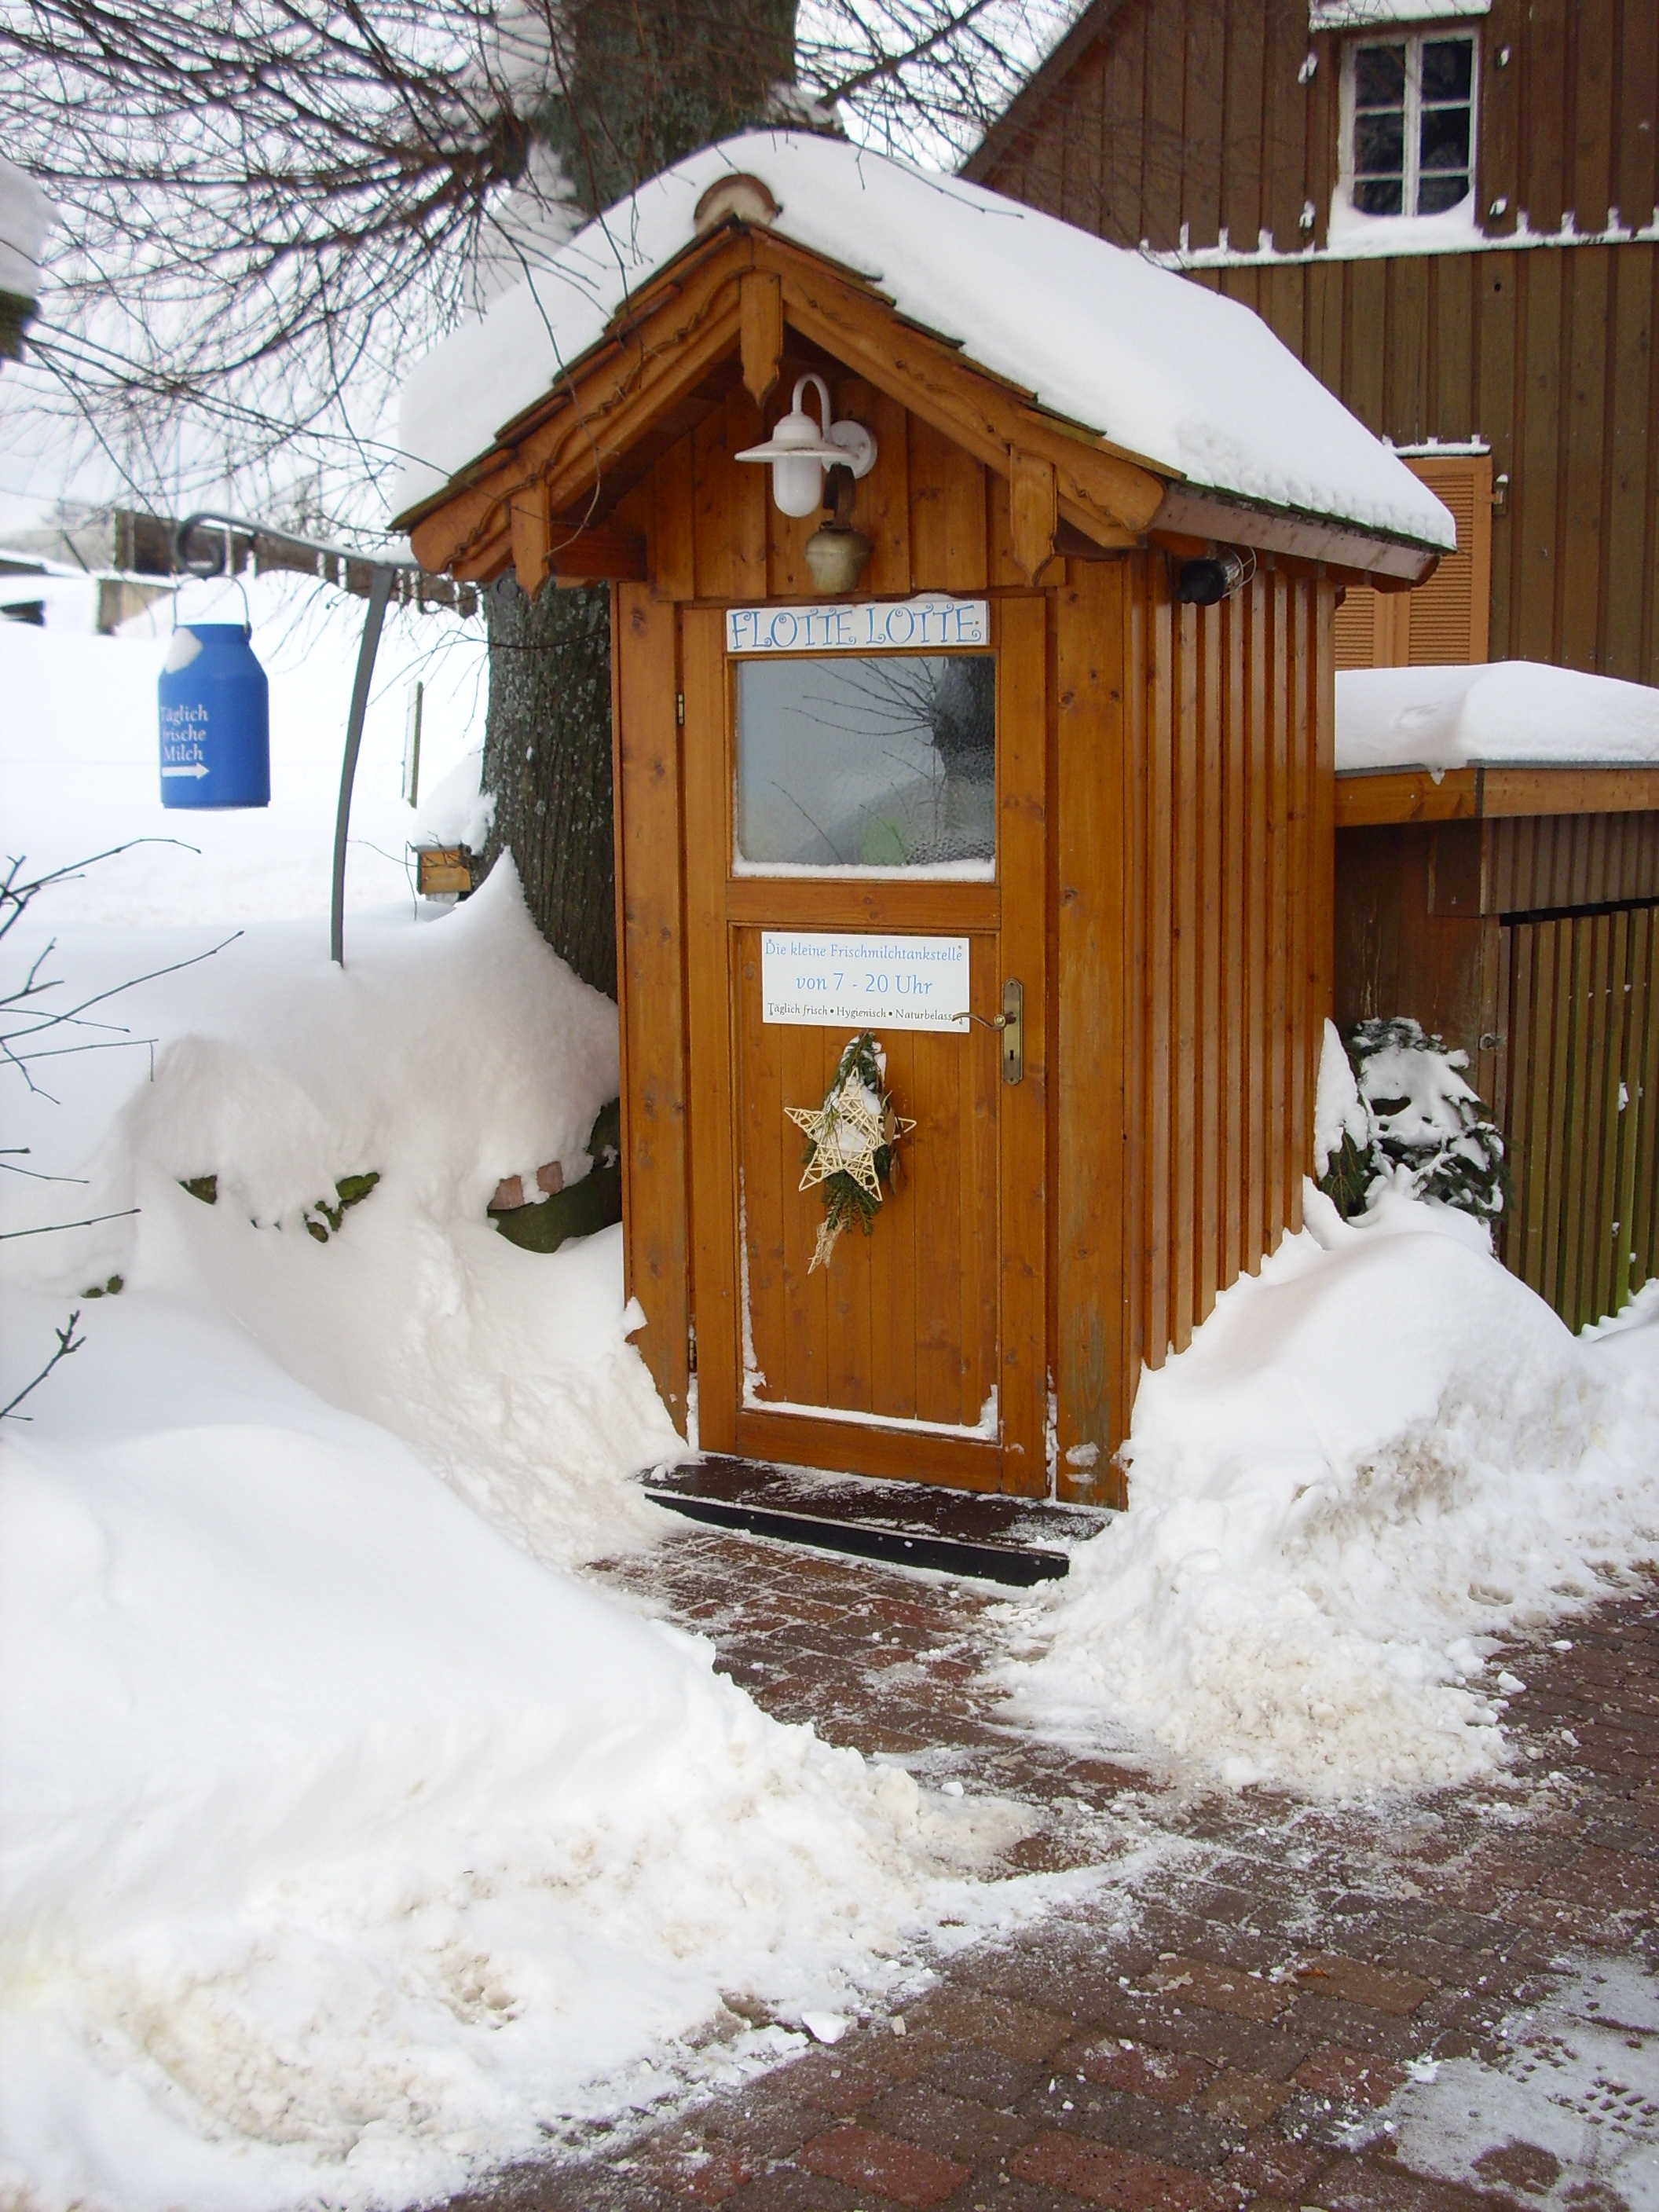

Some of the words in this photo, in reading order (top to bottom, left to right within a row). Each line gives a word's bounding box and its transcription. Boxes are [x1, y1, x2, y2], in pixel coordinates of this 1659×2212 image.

[731, 606, 857, 650] FLOTTE
[866, 602, 982, 644] LOTTE
[160, 704, 208, 726] Täglich
[162, 723, 207, 742] frische
[163, 742, 203, 761] Milch
[765, 941, 786, 955] Die
[790, 942, 826, 957] kleine
[830, 944, 962, 962] Frischmilchtankstelle
[797, 977, 828, 991] von
[833, 972, 844, 991] 7
[865, 973, 888, 993] 20
[895, 975, 932, 994] Uhr
[767, 1002, 800, 1016] Täglich
[802, 1005, 828, 1017] frisch
[837, 1006, 886, 1020] Hygienisch
[895, 1009, 954, 1021] Naturbelass
